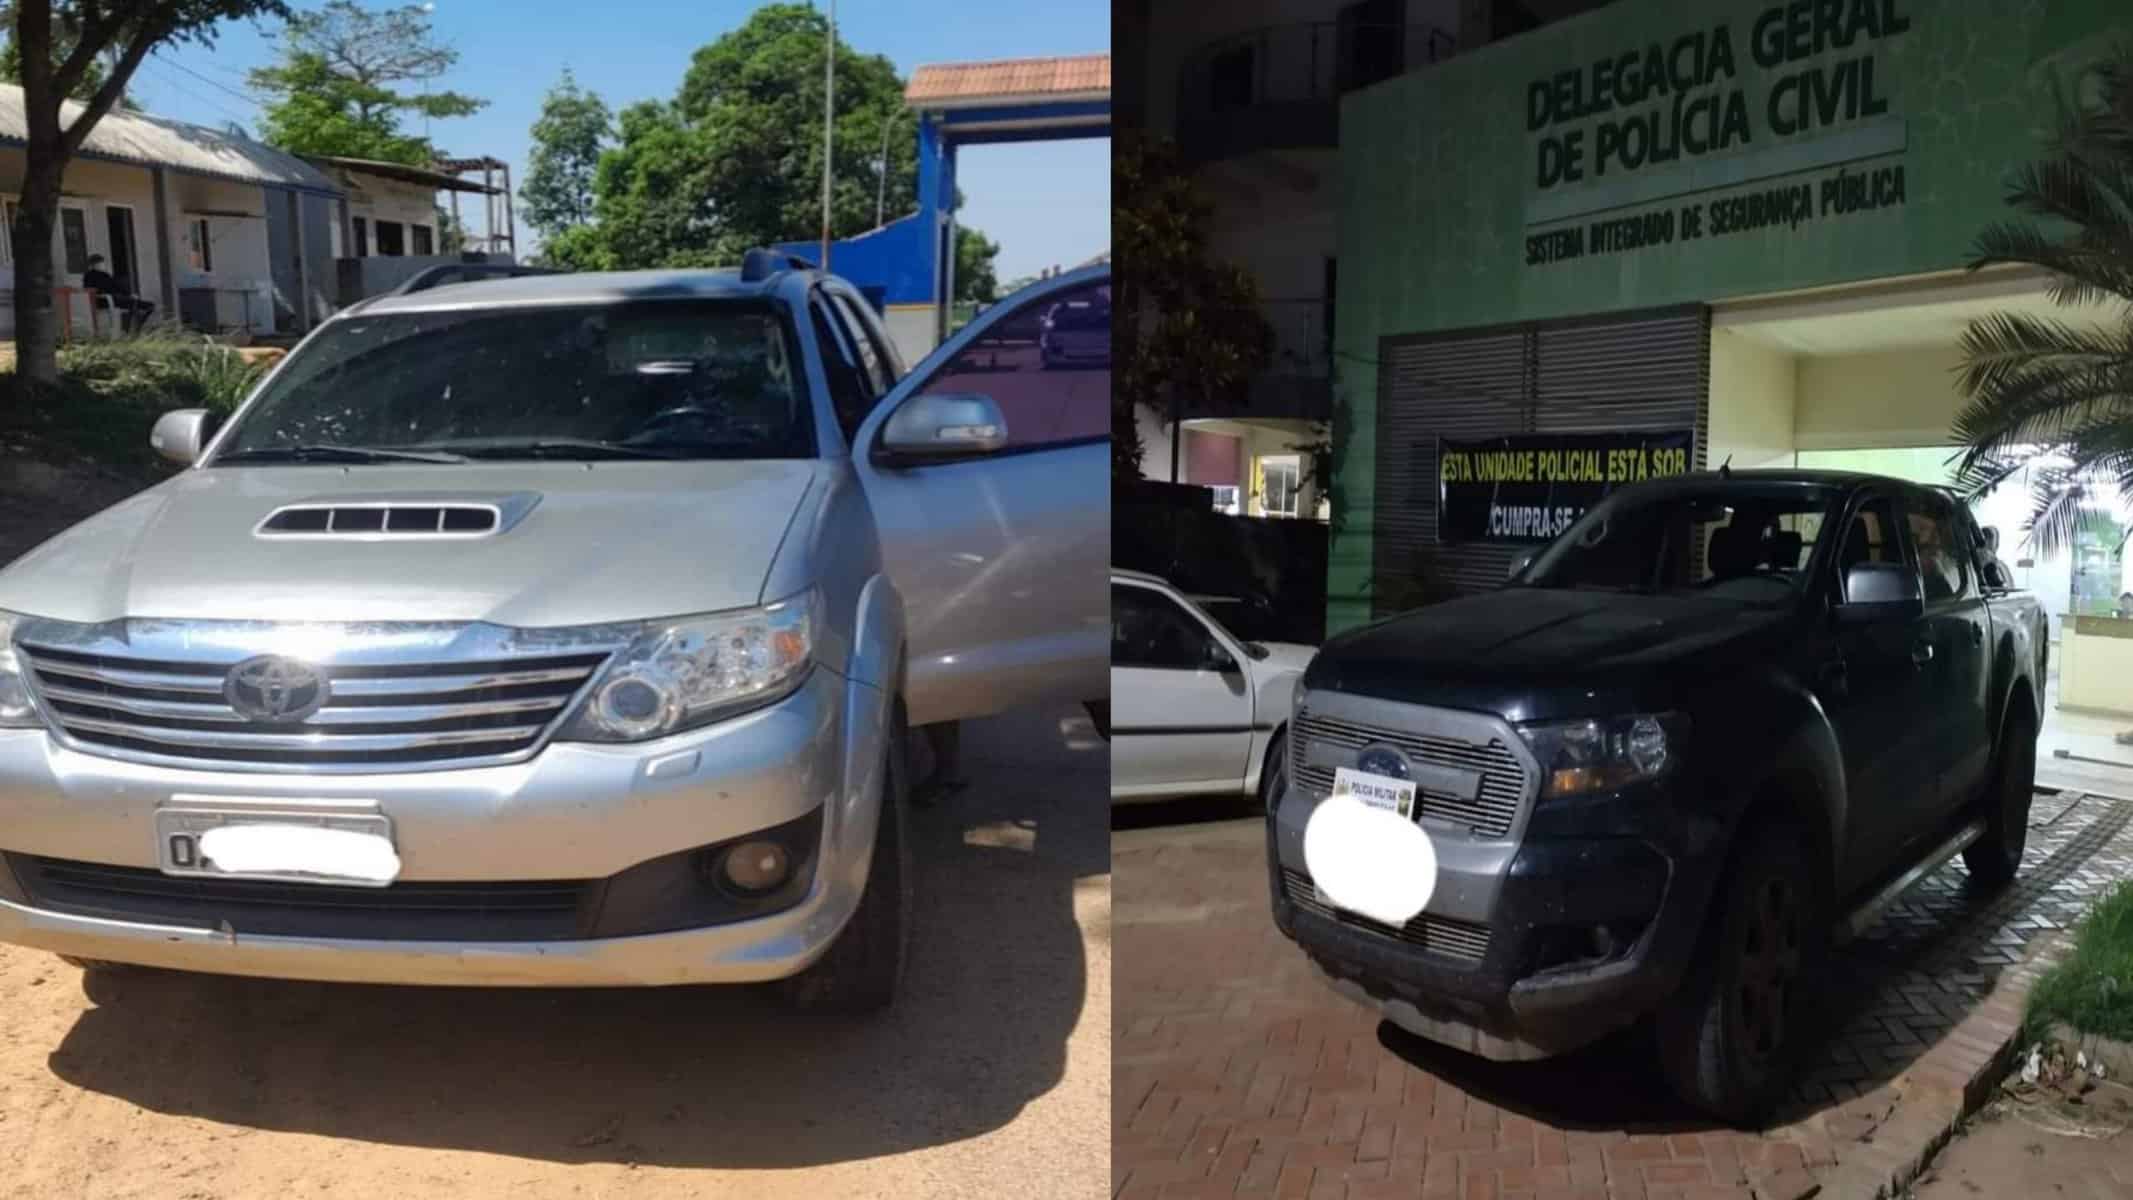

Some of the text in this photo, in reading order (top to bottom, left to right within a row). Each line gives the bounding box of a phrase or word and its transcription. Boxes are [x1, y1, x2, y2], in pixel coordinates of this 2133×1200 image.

[1527, 0, 1910, 131] DELEGACIA GERAL
[1537, 55, 1888, 189] DE POLÍCIA CIVIL
[1525, 166, 1906, 265] SISTEMA INTEGRADO DE SEGURANÇA PÚBLICA
[1440, 452, 1472, 481] ESTA
[1475, 451, 1534, 481] UNIDADE
[1538, 449, 1603, 482] POLICIAL
